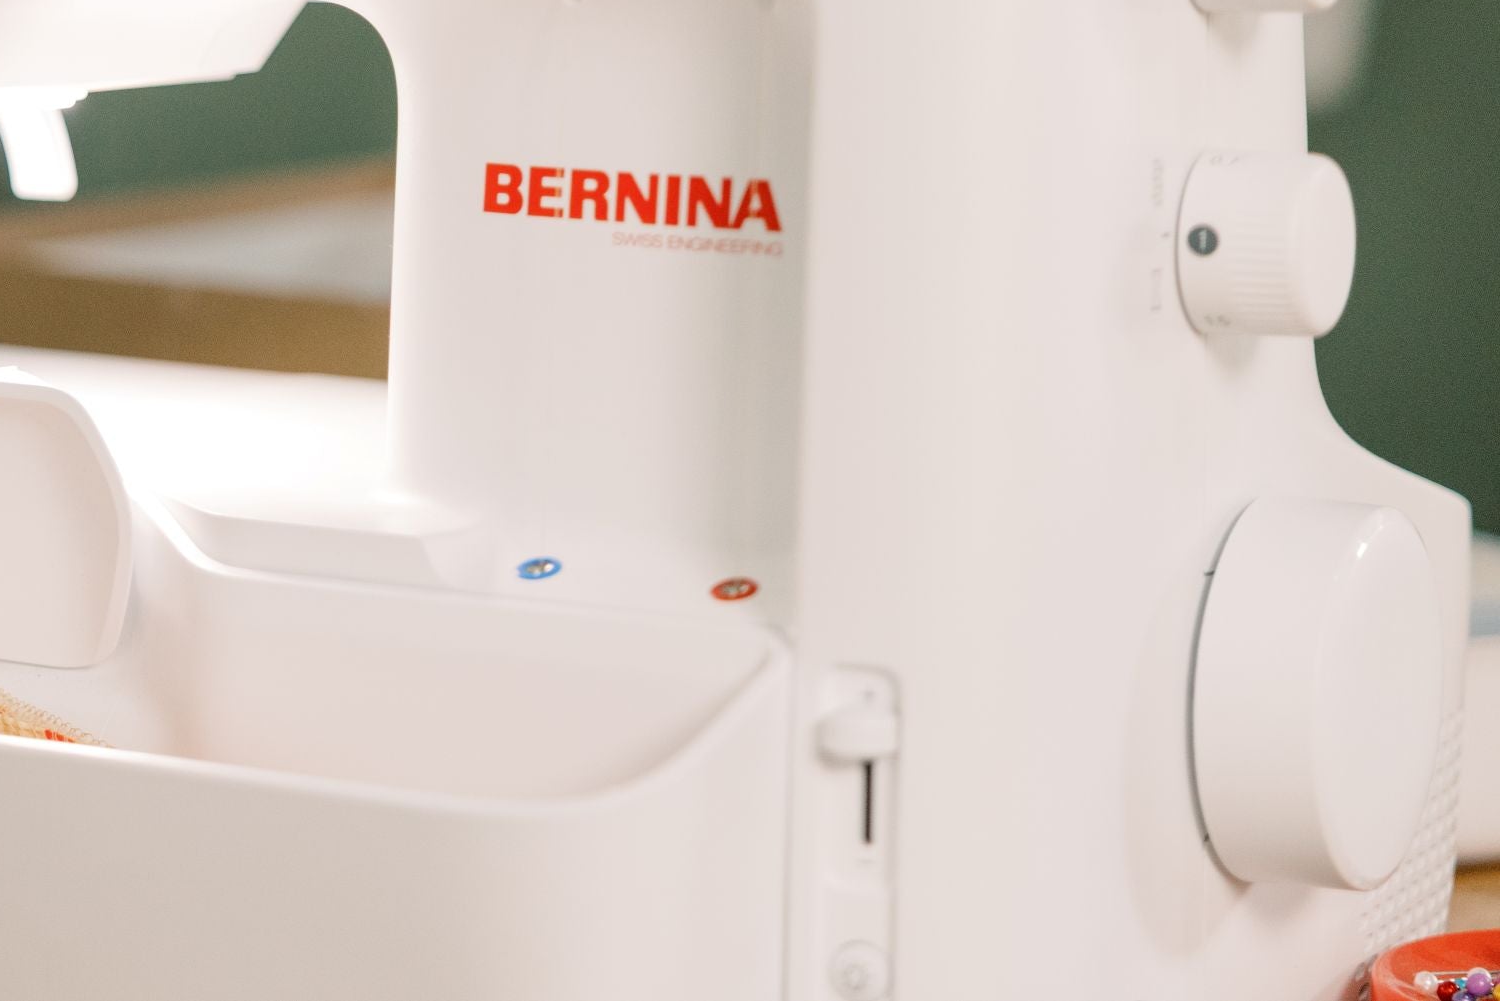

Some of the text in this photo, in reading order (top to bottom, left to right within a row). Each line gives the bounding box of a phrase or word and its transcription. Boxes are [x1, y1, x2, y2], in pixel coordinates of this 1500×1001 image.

[483, 162, 783, 233] BERNINA
[612, 231, 784, 257] SWISS ENGINEERING
